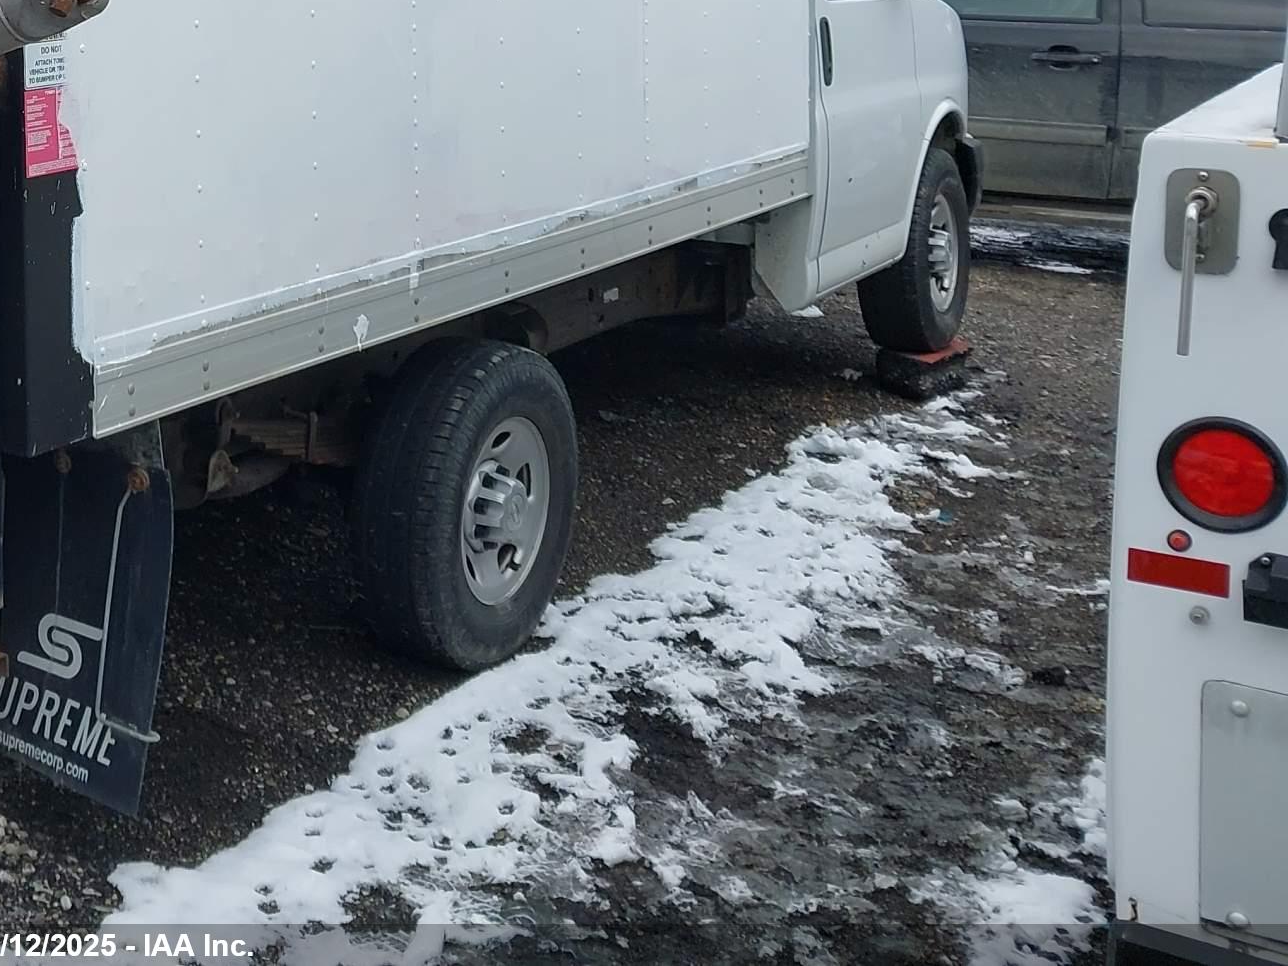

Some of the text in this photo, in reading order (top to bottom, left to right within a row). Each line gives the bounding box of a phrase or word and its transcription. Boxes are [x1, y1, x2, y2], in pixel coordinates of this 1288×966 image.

[40, 45, 62, 54] DO NOT
[35, 58, 52, 66] ATTACH
[35, 75, 55, 84] BUMPER
